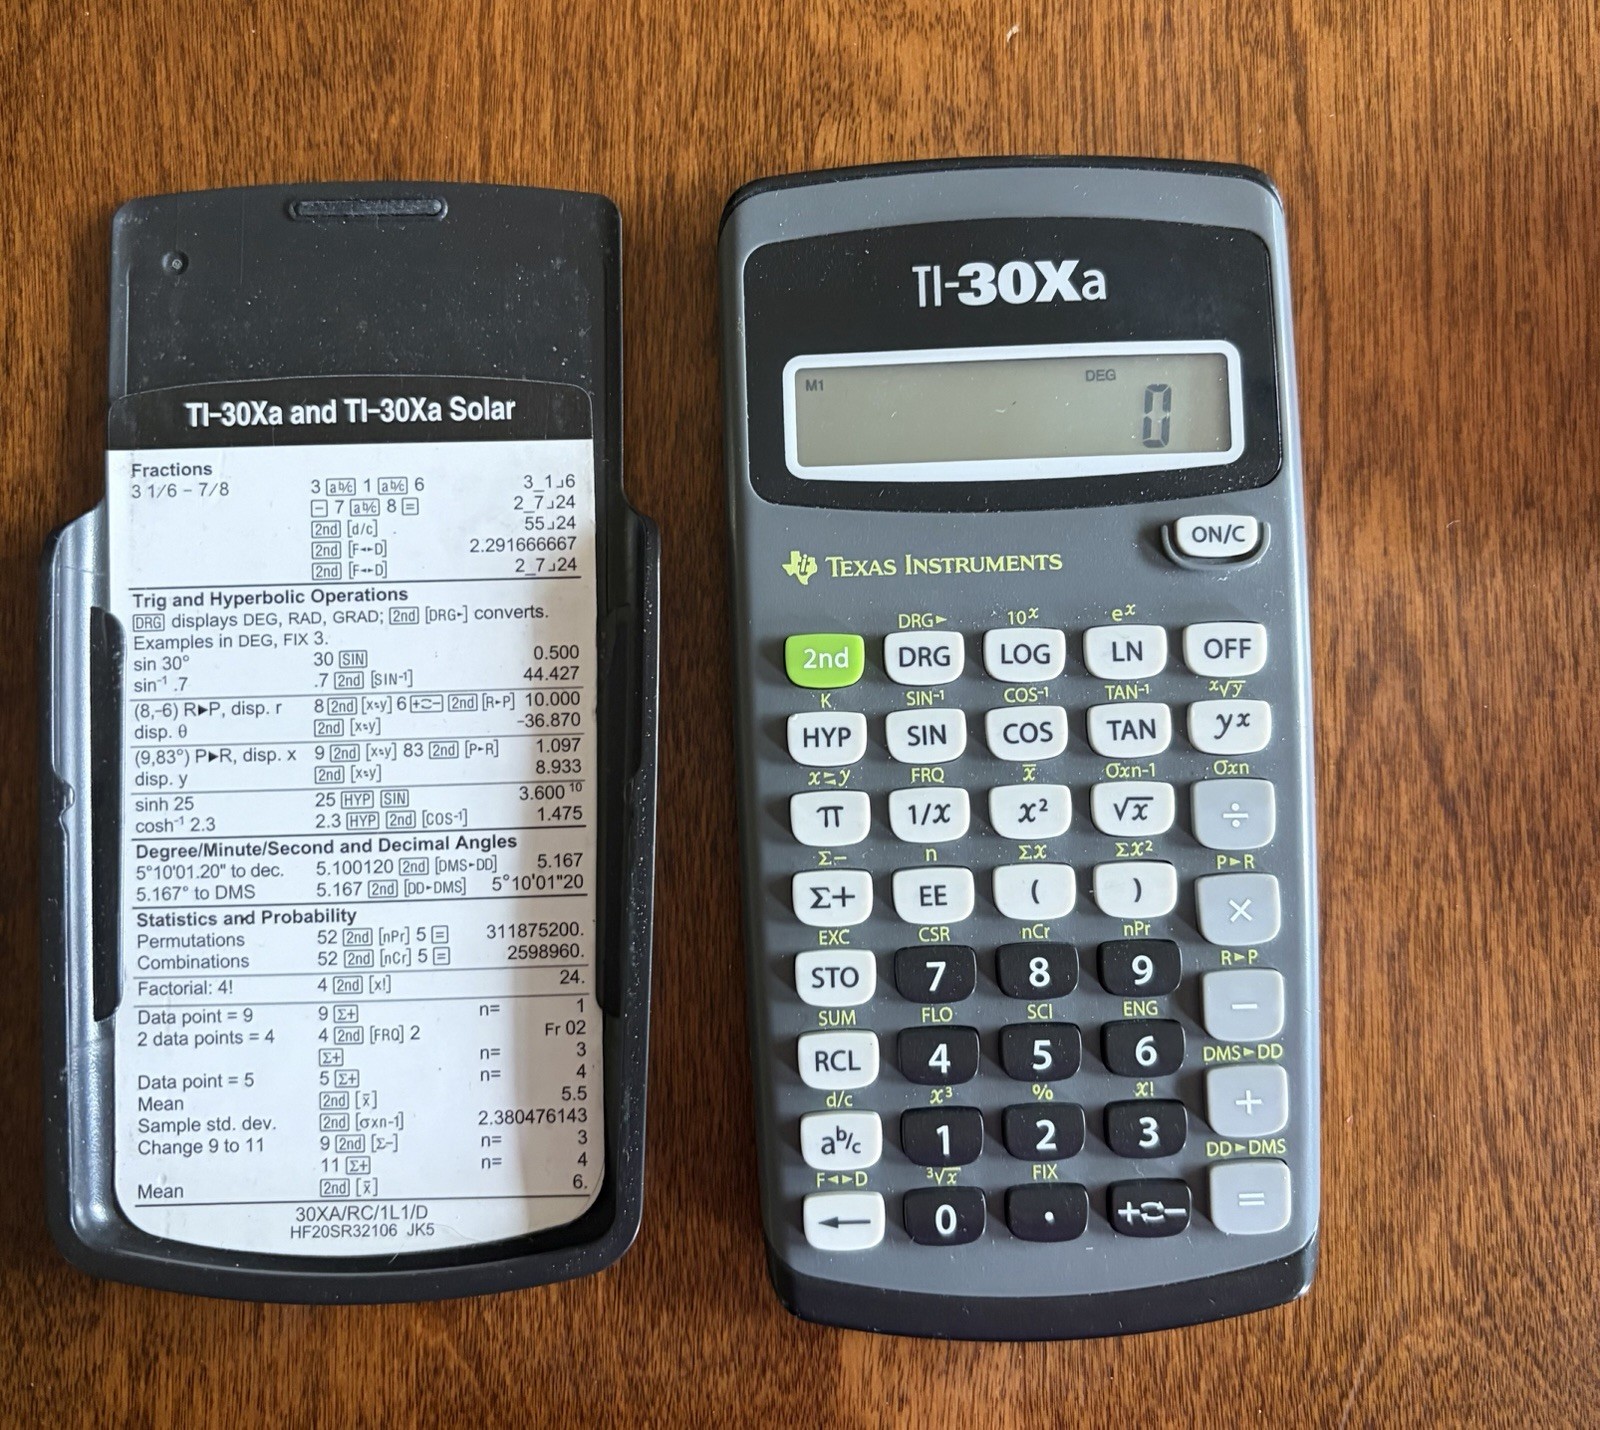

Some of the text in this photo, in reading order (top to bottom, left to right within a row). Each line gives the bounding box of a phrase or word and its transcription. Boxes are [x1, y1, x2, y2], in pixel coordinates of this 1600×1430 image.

[912, 260, 1107, 307] TI-30Xa
[1085, 368, 1117, 382] DEG
[805, 379, 824, 392] M1
[186, 395, 515, 428] TI-30Xa and TI-30Xa Solar
[1141, 383, 1172, 449] 0
[131, 462, 212, 478] Fractions
[146, 482, 229, 498] 1/6 7/8
[315, 523, 338, 536] 2nd
[1191, 525, 1245, 543] ON/C
[470, 536, 576, 553] 2.291666667
[825, 554, 1063, 577] TEXAS INSTRUMENTS
[132, 587, 408, 611] Trig and Hyperbolic Operations
[135, 606, 548, 630] DRG displays DEG, RAD, GRAD; converts.
[898, 612, 934, 629] DRG
[134, 631, 328, 651] Examples in DEG, FIX 3.
[1204, 639, 1251, 659] OFF
[313, 652, 364, 667] 30 SIN
[534, 645, 579, 660] 0.500
[803, 648, 849, 669] 2nd
[900, 646, 951, 667] DRG
[1001, 644, 1050, 665] LOG
[1113, 642, 1143, 661] LN
[134, 655, 189, 671] sin 30°
[337, 673, 361, 687] 2nd
[524, 666, 579, 681] 44.427
[525, 691, 580, 708] 10.000
[821, 694, 832, 708] K
[231, 701, 270, 718] disp.
[518, 712, 581, 729] -36.870
[135, 724, 173, 742] disp.
[803, 726, 851, 747] HYP
[907, 724, 947, 746] SIN
[1003, 722, 1053, 744] COS
[1107, 719, 1157, 740] TAN
[333, 746, 357, 760] 2nd
[403, 743, 424, 757] 83
[537, 738, 581, 754] 1.097
[242, 747, 282, 765] disp.
[536, 759, 582, 775] 8.933
[911, 767, 945, 784] FRQ
[135, 772, 173, 790] disp.
[315, 791, 406, 807] 25 HYP SIN
[519, 785, 564, 801] 3.600
[136, 797, 194, 812] sinh 25
[315, 814, 377, 829] 2.3 HYP
[538, 806, 583, 821] 1.475
[190, 817, 216, 832] 2.3
[136, 834, 518, 860] Degree/Minute/Second and Decimal Angles
[925, 848, 937, 862] n
[316, 859, 426, 875] 5.100120 2nd
[538, 853, 583, 869] 5.167
[230, 862, 284, 879] to dec.
[194, 886, 211, 901] to
[215, 884, 256, 899] DMS
[317, 882, 363, 898] 5.167
[919, 886, 948, 906] EE
[137, 908, 357, 928] Statistics and Probability
[317, 930, 338, 945] 52
[486, 922, 583, 940] 311875200.
[819, 929, 850, 945] EXC
[918, 927, 950, 942] CSR
[1022, 924, 1050, 940] nCr
[1124, 922, 1151, 938] nPr
[137, 932, 245, 949] Permutations
[317, 951, 338, 966] 52
[508, 944, 584, 960] 2598960.
[137, 954, 250, 971] Combinations
[1131, 955, 1153, 984] 9
[560, 970, 585, 985] 24.
[812, 967, 859, 989] STO
[928, 961, 946, 992] 7
[1028, 957, 1050, 987] 8
[138, 979, 233, 996] Factorial: 4!
[336, 978, 360, 992] 2nd
[922, 1007, 952, 1023] FLO
[1027, 1004, 1053, 1020] SCI
[1124, 1001, 1158, 1017] ENG
[138, 1009, 222, 1027] Data point
[818, 1010, 856, 1026] SUM
[545, 1020, 586, 1036] Fr 02
[153, 1030, 243, 1049] data points
[928, 1043, 950, 1073] 4
[1032, 1040, 1051, 1070] 5
[1135, 1036, 1157, 1066] 6
[1204, 1043, 1283, 1062] DMS DD
[815, 1050, 861, 1072] RCL
[138, 1073, 222, 1092] Data point
[562, 1086, 588, 1101] 5.5
[826, 1092, 853, 1108] d/c
[1033, 1085, 1053, 1100] %
[137, 1097, 184, 1111] Mean
[138, 1116, 276, 1135] Sample std. dev.
[479, 1109, 587, 1125] 2.380476143
[938, 1124, 952, 1155] 1
[1036, 1120, 1056, 1150] 2
[1139, 1117, 1159, 1147] 3
[137, 1138, 264, 1157] Change to 11
[338, 1136, 362, 1150] 2nd
[1206, 1138, 1285, 1156] DD DMS
[321, 1158, 340, 1172] 11
[1033, 1165, 1058, 1180] FIX
[137, 1184, 184, 1198] Mean
[572, 1175, 588, 1190] 6.
[935, 1204, 957, 1236] 0
[290, 1222, 435, 1239] HF20SR32106 JK5
